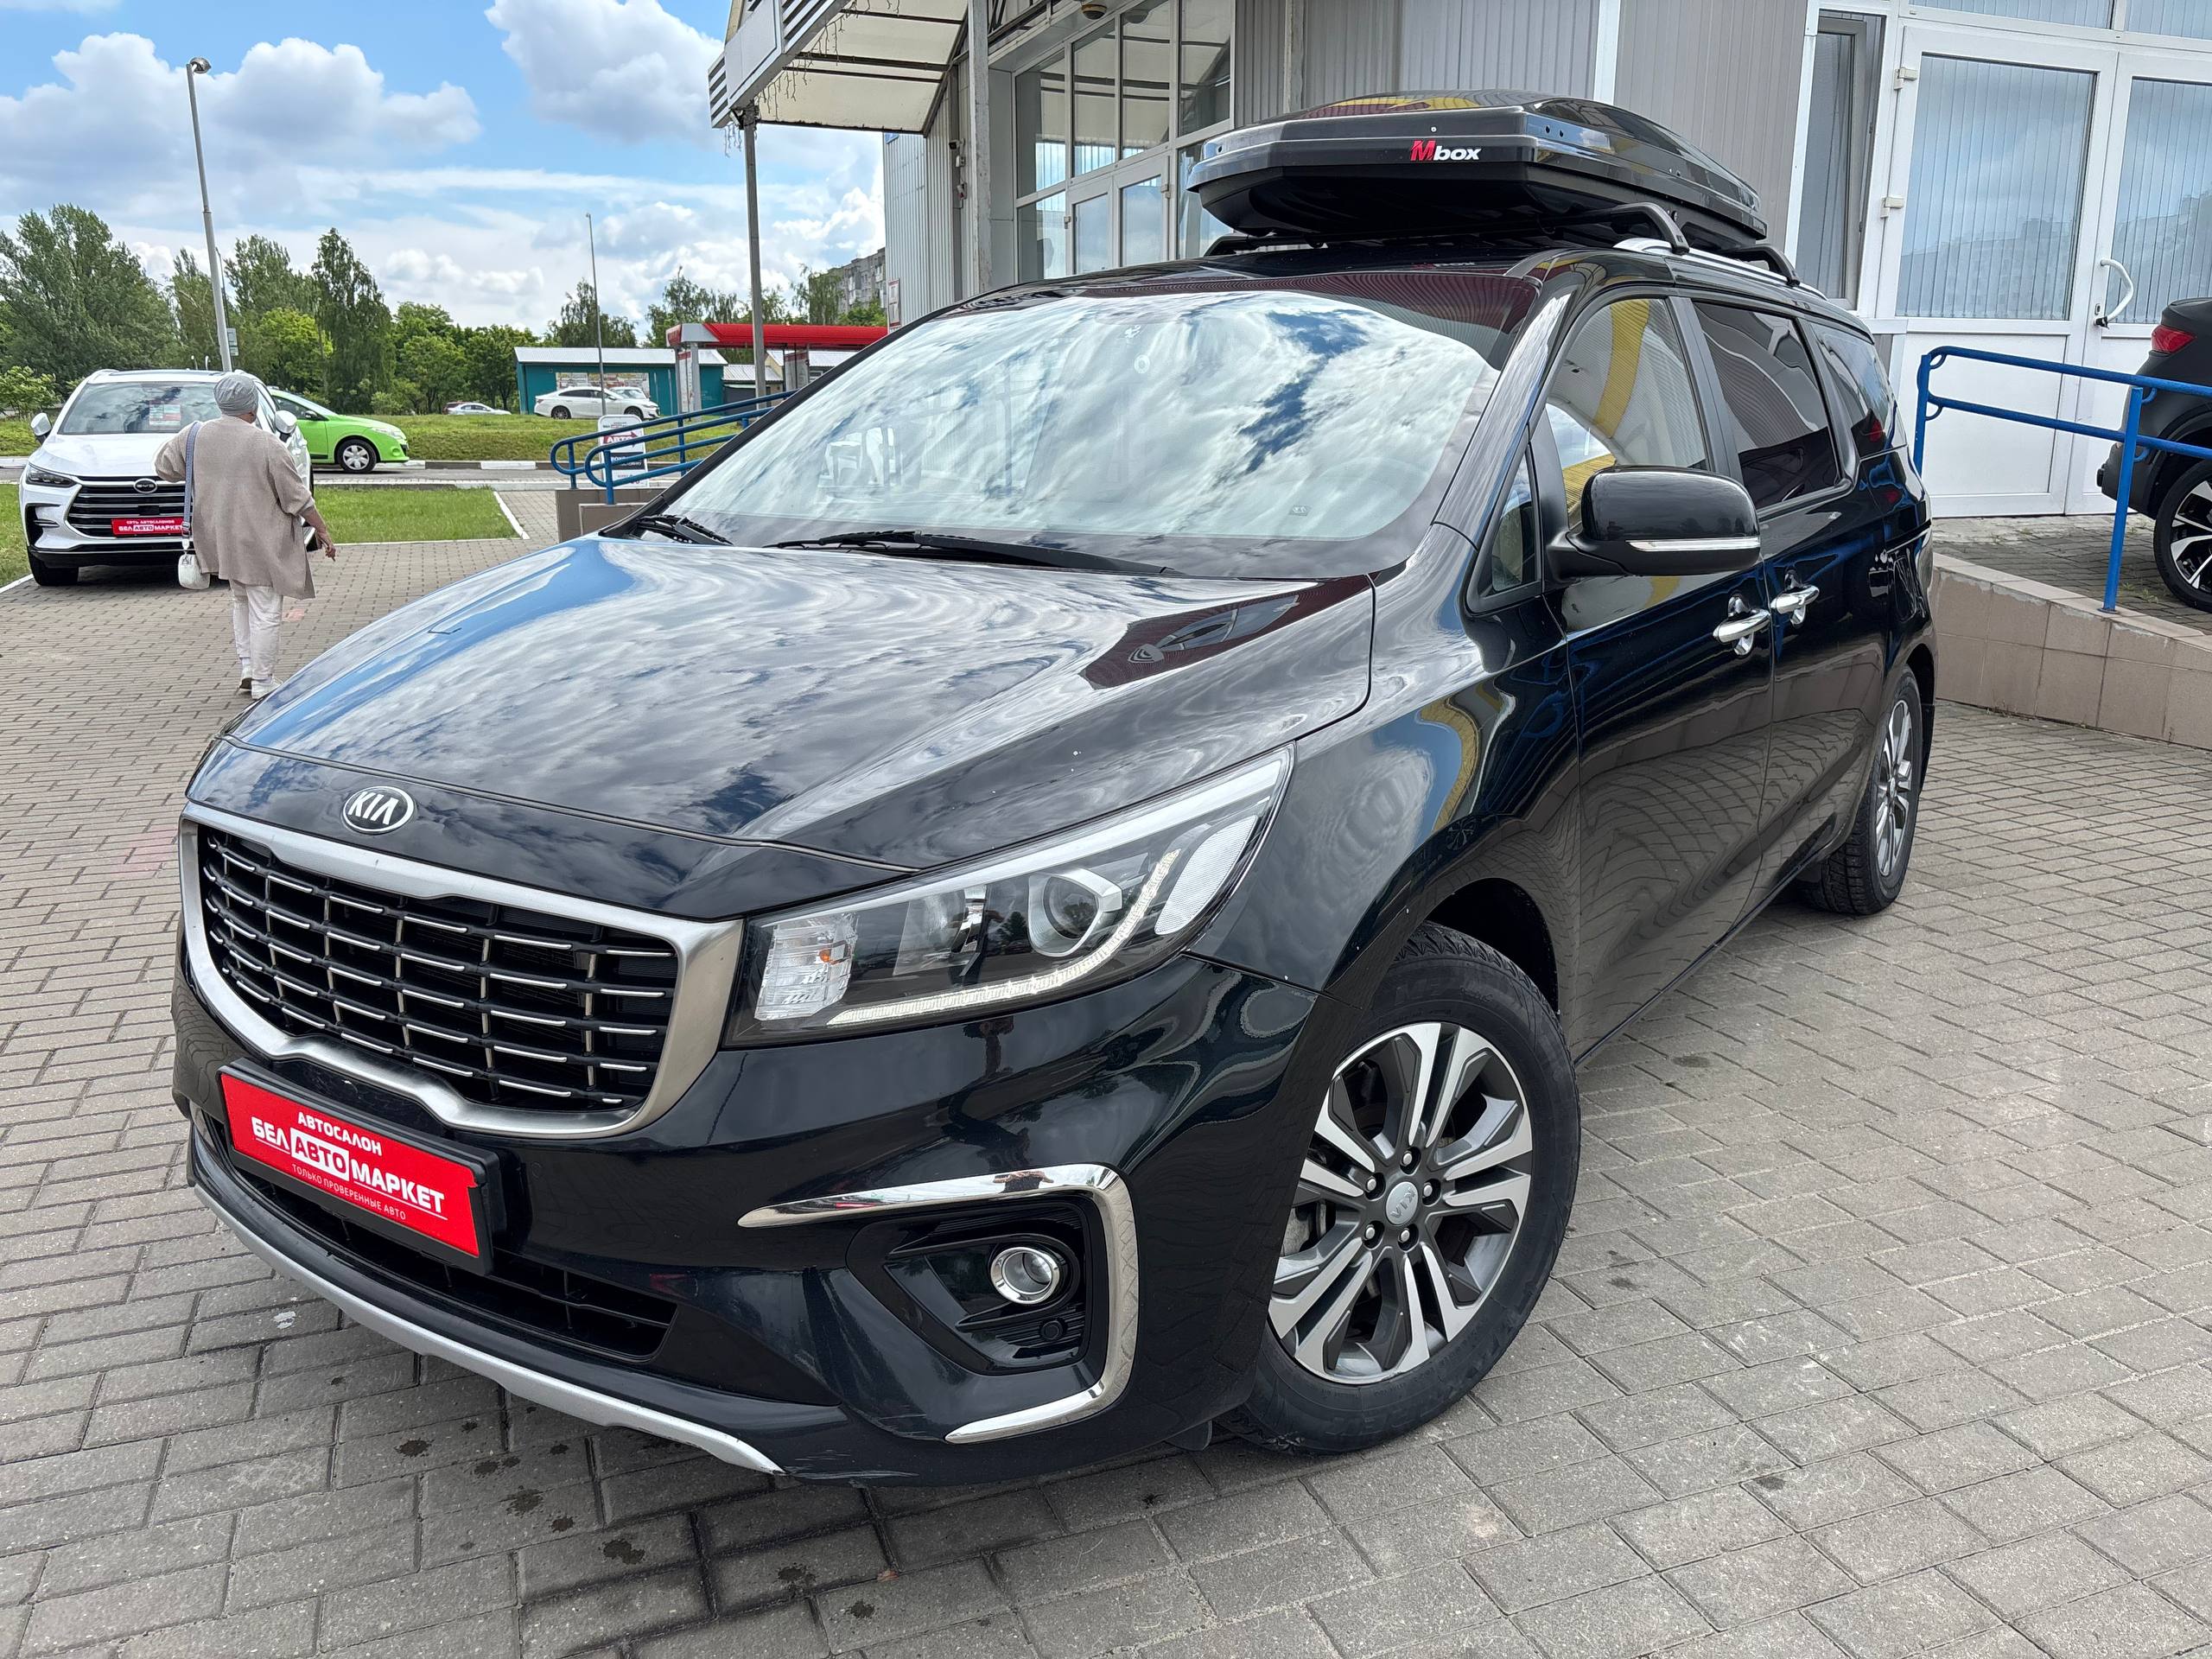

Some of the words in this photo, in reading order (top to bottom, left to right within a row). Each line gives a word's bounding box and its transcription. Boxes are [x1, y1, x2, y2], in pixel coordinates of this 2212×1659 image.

[1410, 140, 1481, 162] Mbox
[347, 791, 399, 825] KIA
[297, 1111, 382, 1156] АВТОСАЛОН
[291, 1163, 322, 1185] ТОЛЬКО
[323, 1178, 382, 1211] ПРОВЕРЕННЫЕ
[384, 1204, 406, 1220] АВТО
[1389, 1188, 1415, 1218] KIA
